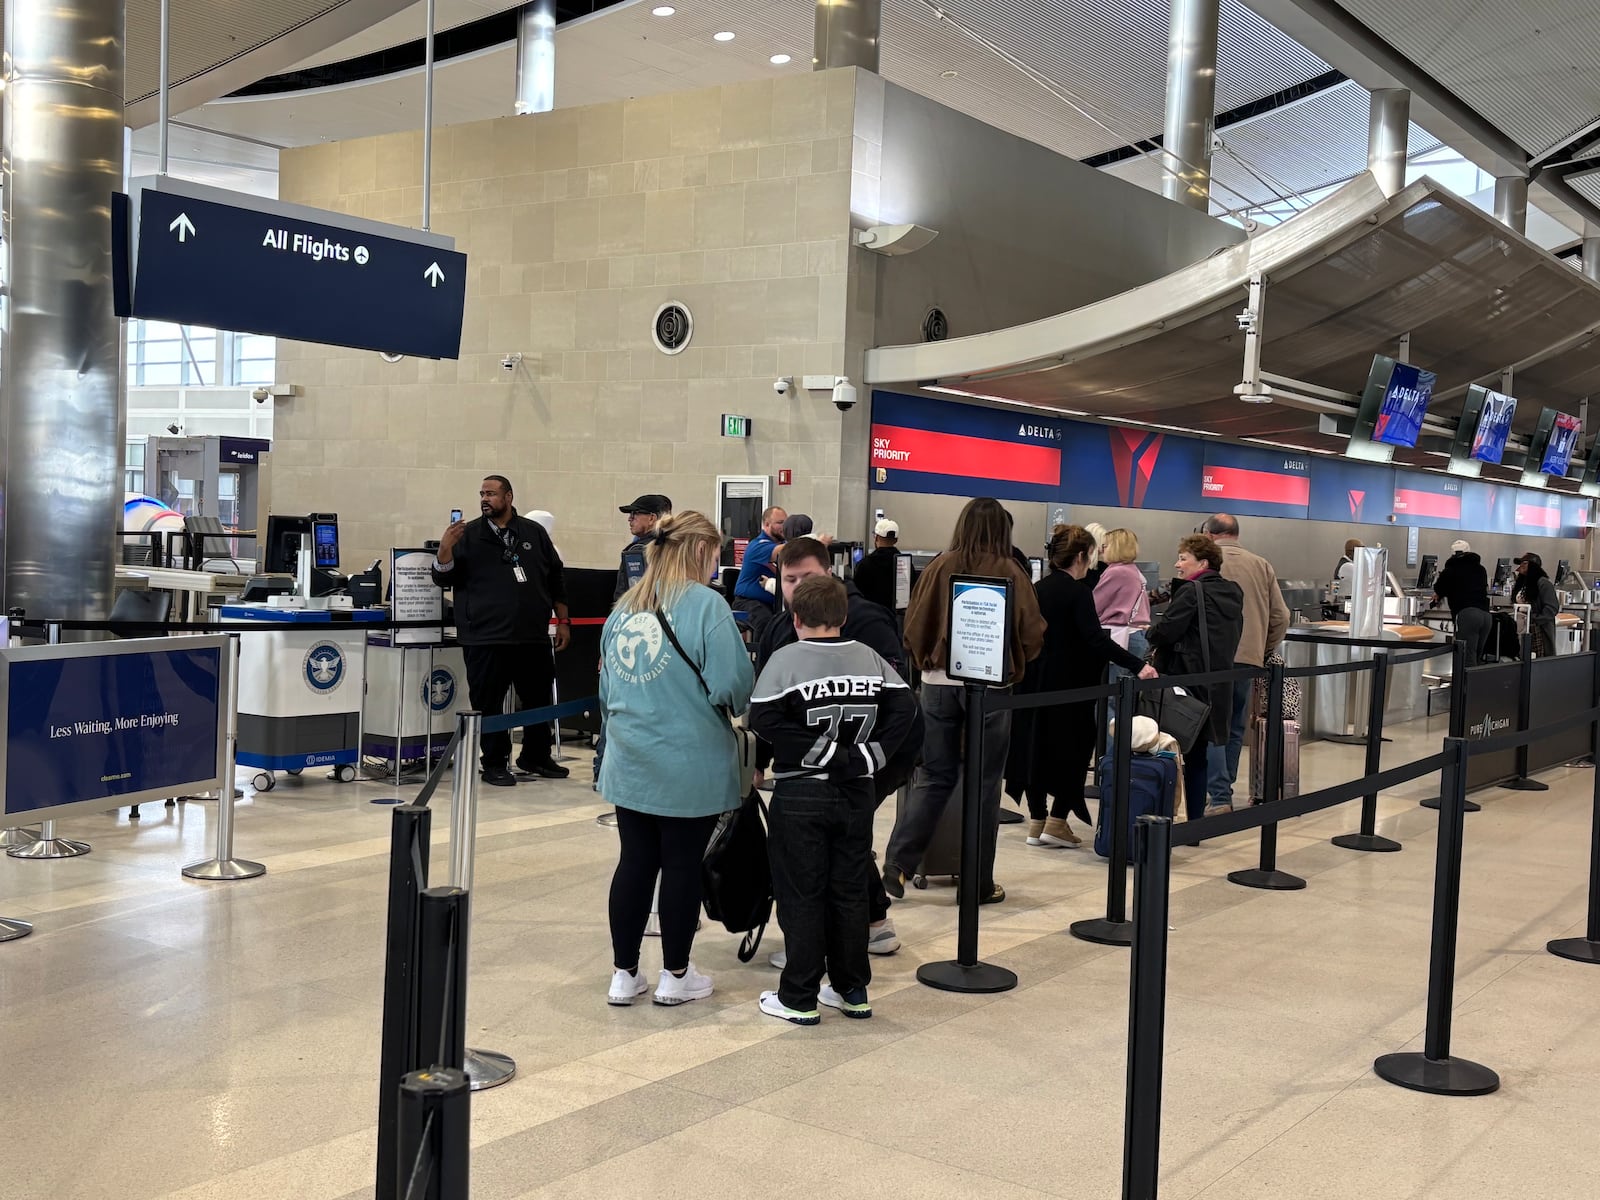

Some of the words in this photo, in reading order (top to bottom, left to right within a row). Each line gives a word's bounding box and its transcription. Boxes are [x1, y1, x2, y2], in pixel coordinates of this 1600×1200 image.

[262, 228, 288, 250] All
[292, 233, 350, 261] Flights
[1398, 386, 1420, 403] DELTA
[727, 416, 744, 436] EXIT
[1027, 424, 1055, 439] DELTA
[873, 437, 891, 449] SKY
[873, 448, 911, 461] PRIORITY
[1288, 460, 1305, 471] DELTA
[639, 651, 672, 683] QUALITY
[50, 725, 72, 739] Less
[74, 719, 113, 735] Waiting,
[114, 717, 139, 731] More
[140, 711, 179, 729] Enjoying
[315, 755, 336, 763] IDEMIA
